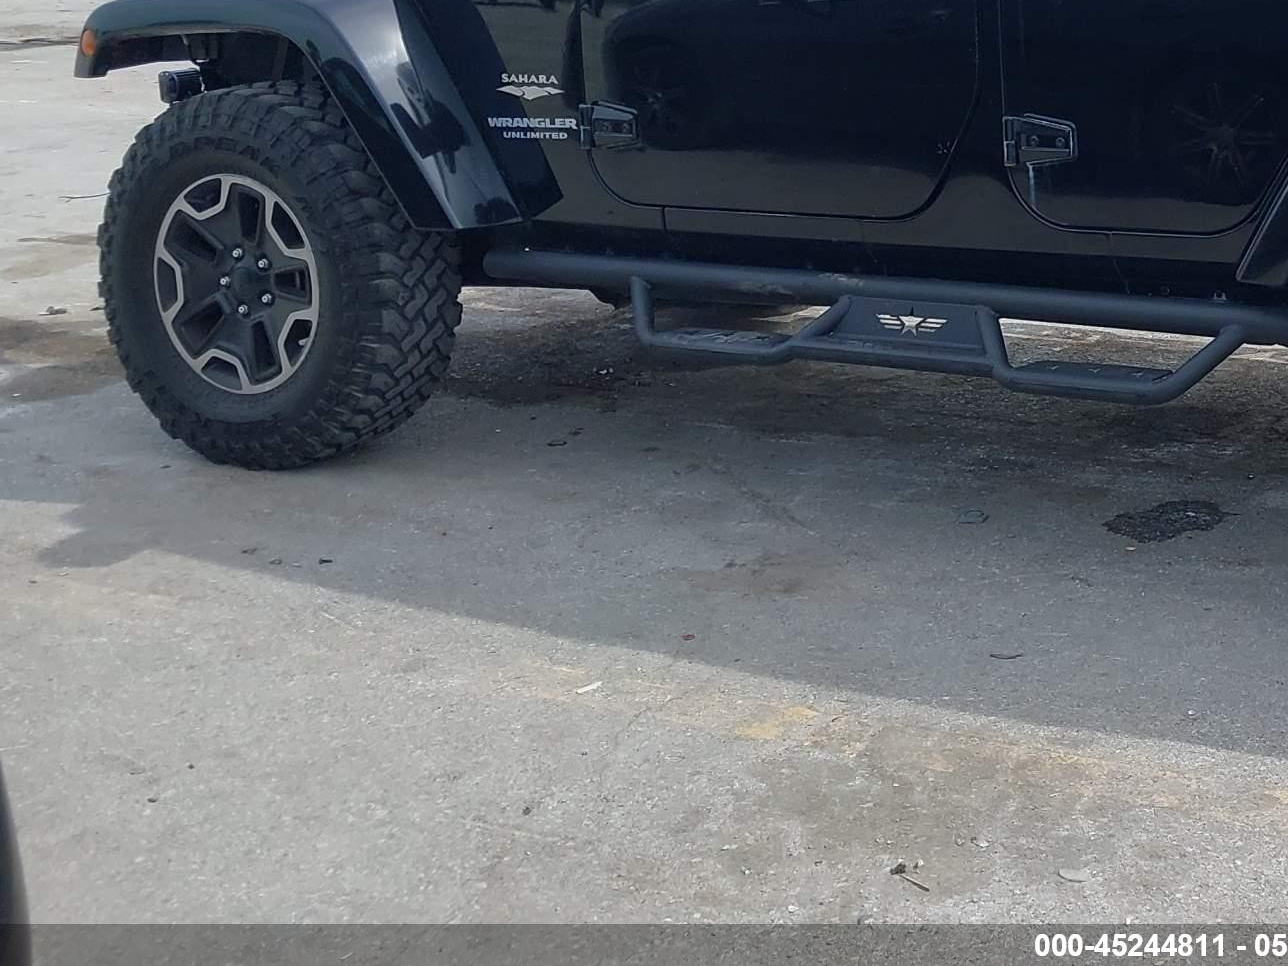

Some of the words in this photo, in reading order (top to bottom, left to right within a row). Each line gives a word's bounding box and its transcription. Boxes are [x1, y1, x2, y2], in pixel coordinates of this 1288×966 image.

[501, 73, 559, 85] SAHARA
[488, 117, 579, 130] WRANGLER
[503, 131, 568, 140] UNLIMITED
